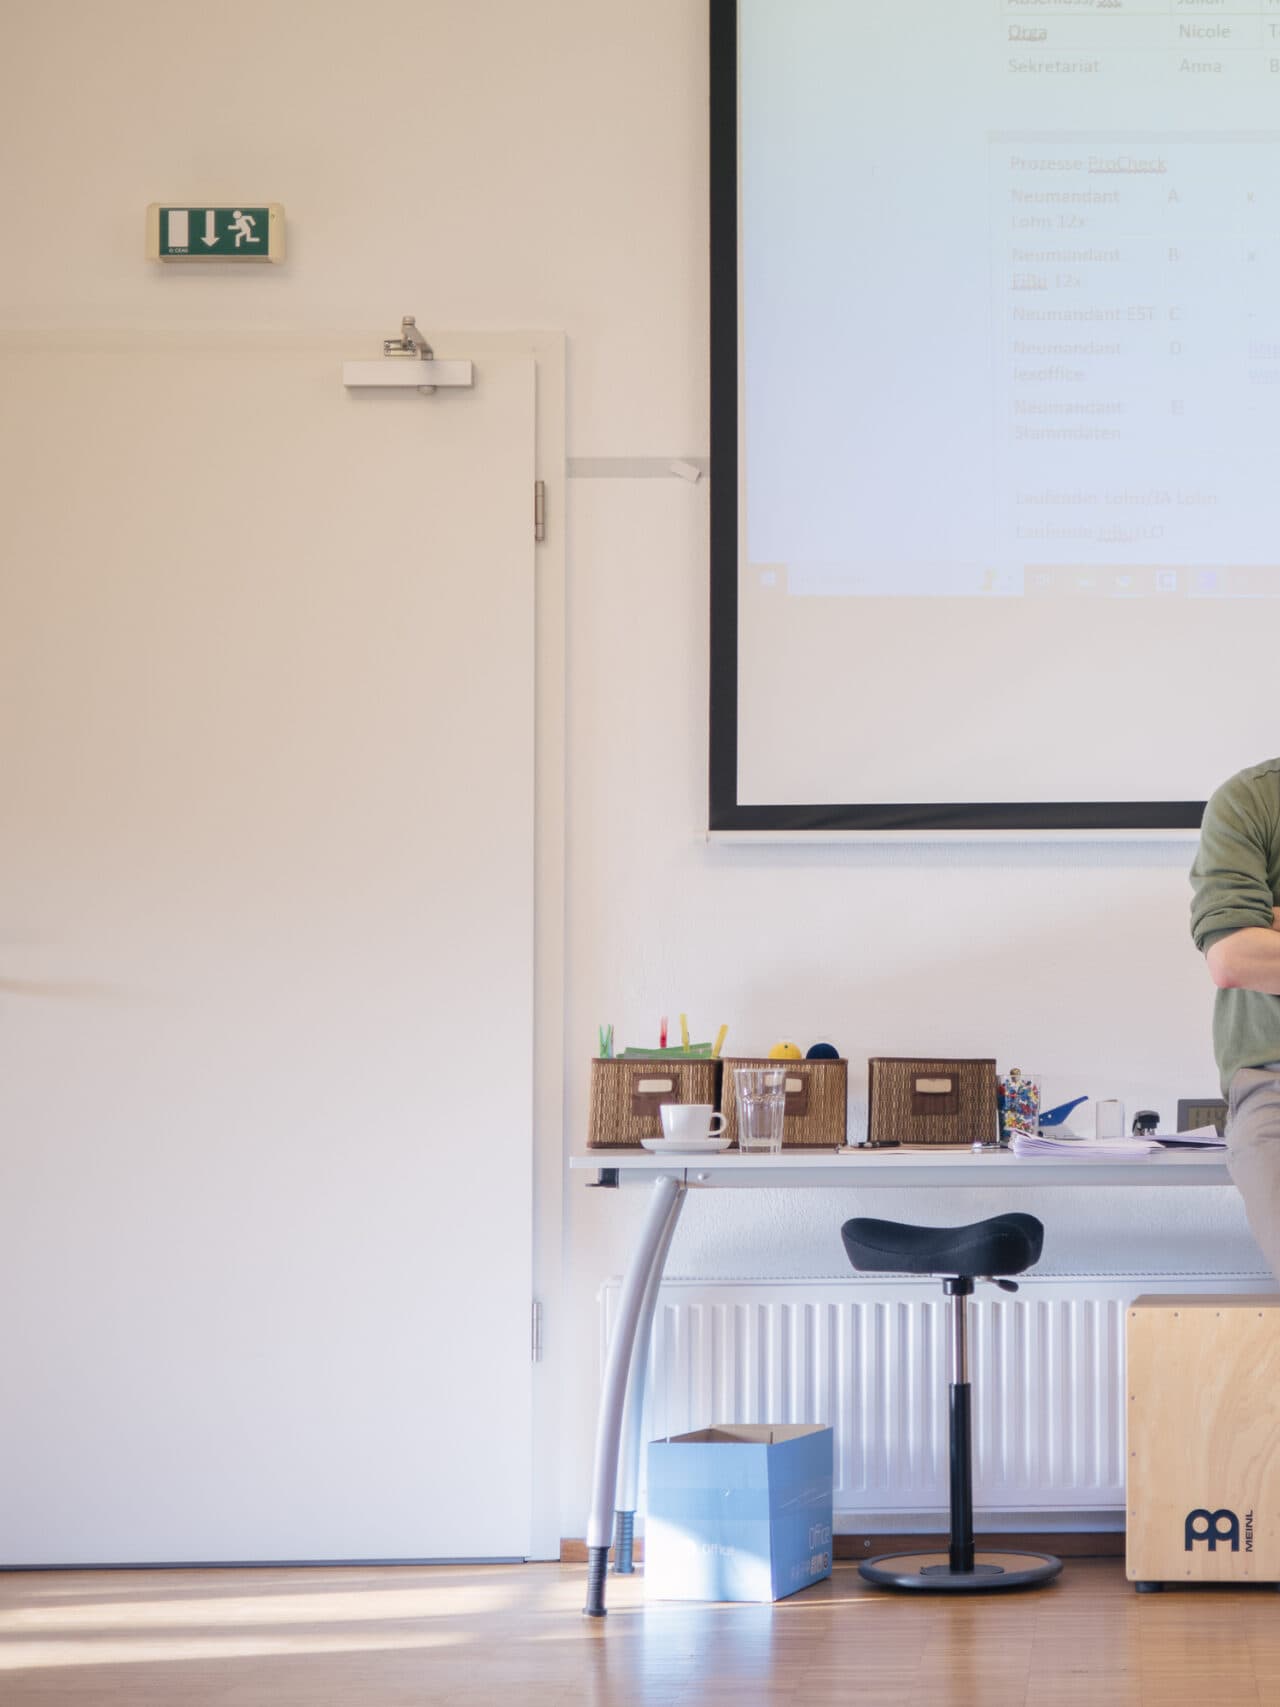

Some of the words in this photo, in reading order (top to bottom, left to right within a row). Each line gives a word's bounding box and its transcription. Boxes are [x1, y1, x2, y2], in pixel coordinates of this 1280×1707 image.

[1008, 25, 1047, 41] Orga
[1179, 24, 1231, 39] Nicole
[1008, 59, 1100, 74] Sekretariat
[1179, 59, 1222, 74] Anna
[1010, 156, 1083, 171] Prozesse
[1088, 156, 1167, 172] ProCheck
[1167, 188, 1180, 203] A
[1056, 214, 1086, 229] 12x
[1013, 306, 1121, 321] Neumandant
[1245, 1509, 1254, 1553] MEINL
